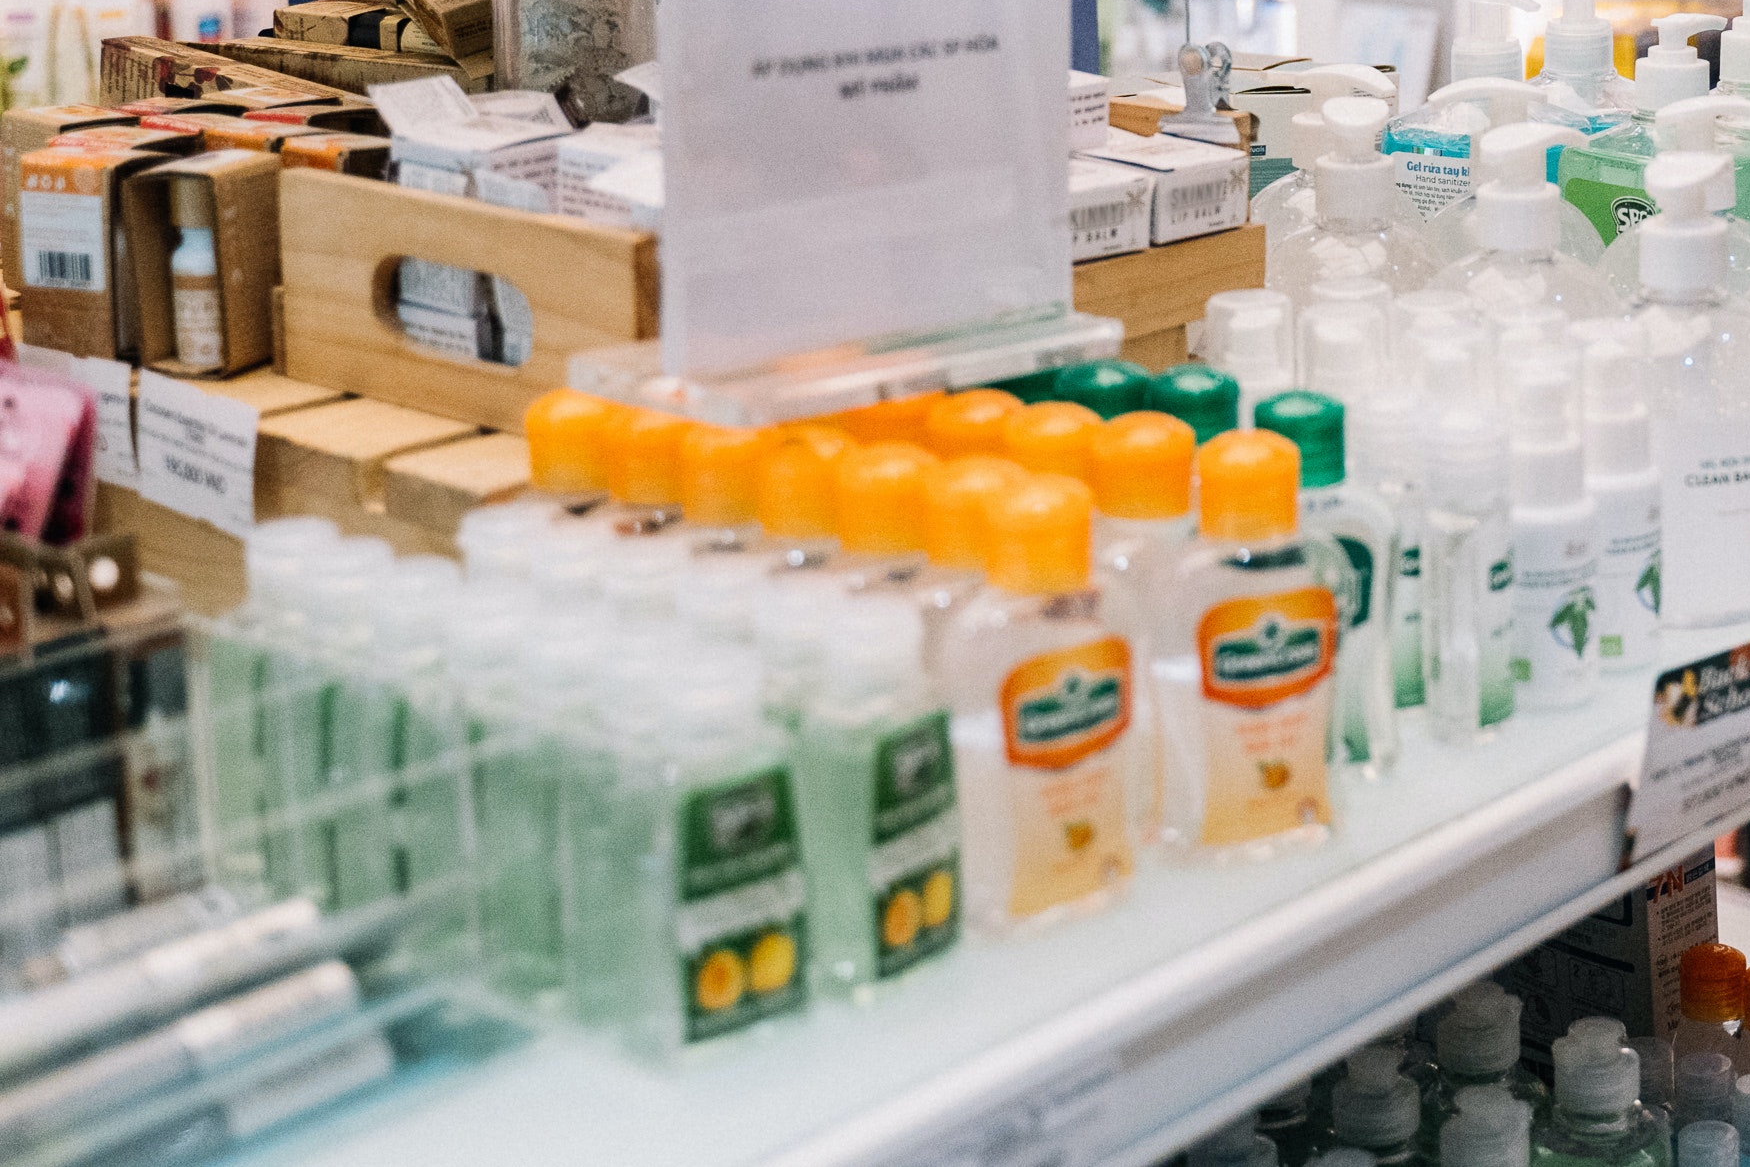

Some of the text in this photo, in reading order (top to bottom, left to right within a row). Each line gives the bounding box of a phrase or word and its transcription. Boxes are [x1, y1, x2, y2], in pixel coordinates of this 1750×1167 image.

[1406, 160, 1421, 172] Gel
[1423, 162, 1441, 175] rửa
[1443, 166, 1459, 178] tay
[1415, 174, 1436, 184] Hand
[1683, 472, 1730, 488] CLEAN
